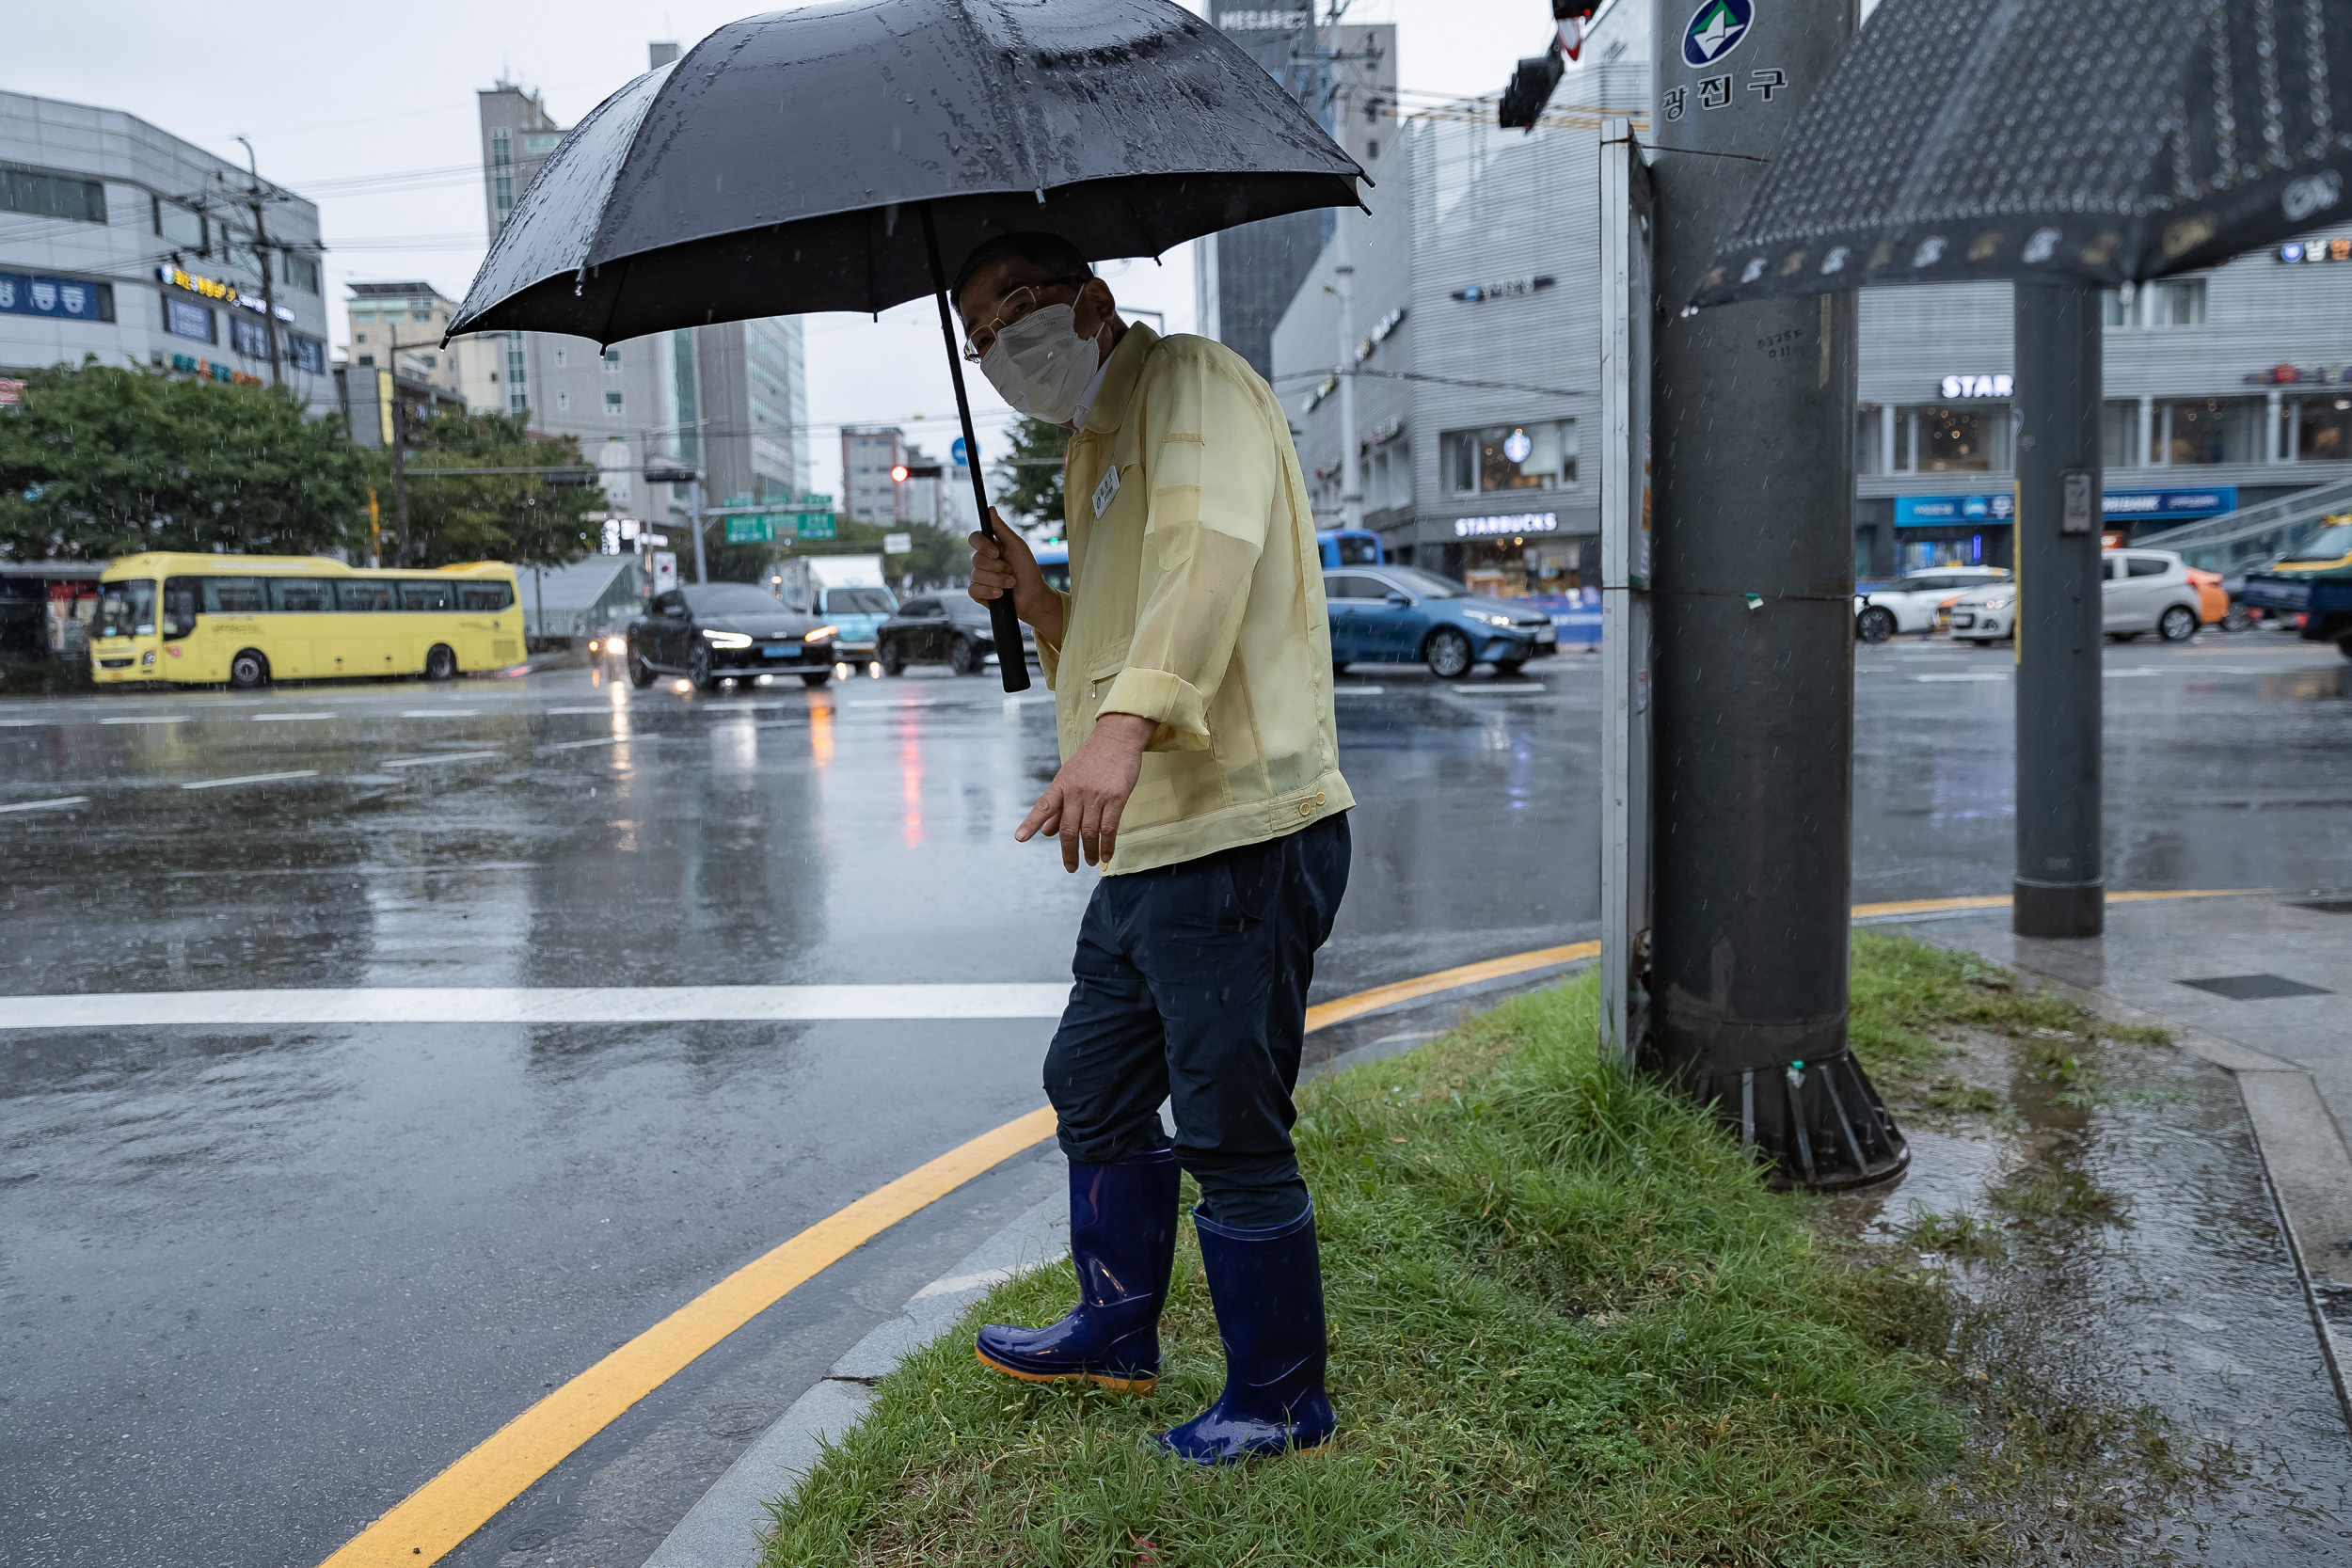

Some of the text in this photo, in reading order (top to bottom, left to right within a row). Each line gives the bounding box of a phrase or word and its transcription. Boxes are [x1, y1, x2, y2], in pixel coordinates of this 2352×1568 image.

[1661, 67, 1788, 122] 광진구
[1942, 374, 2014, 398] STAR
[1454, 512, 1558, 537] STARBUCKS
